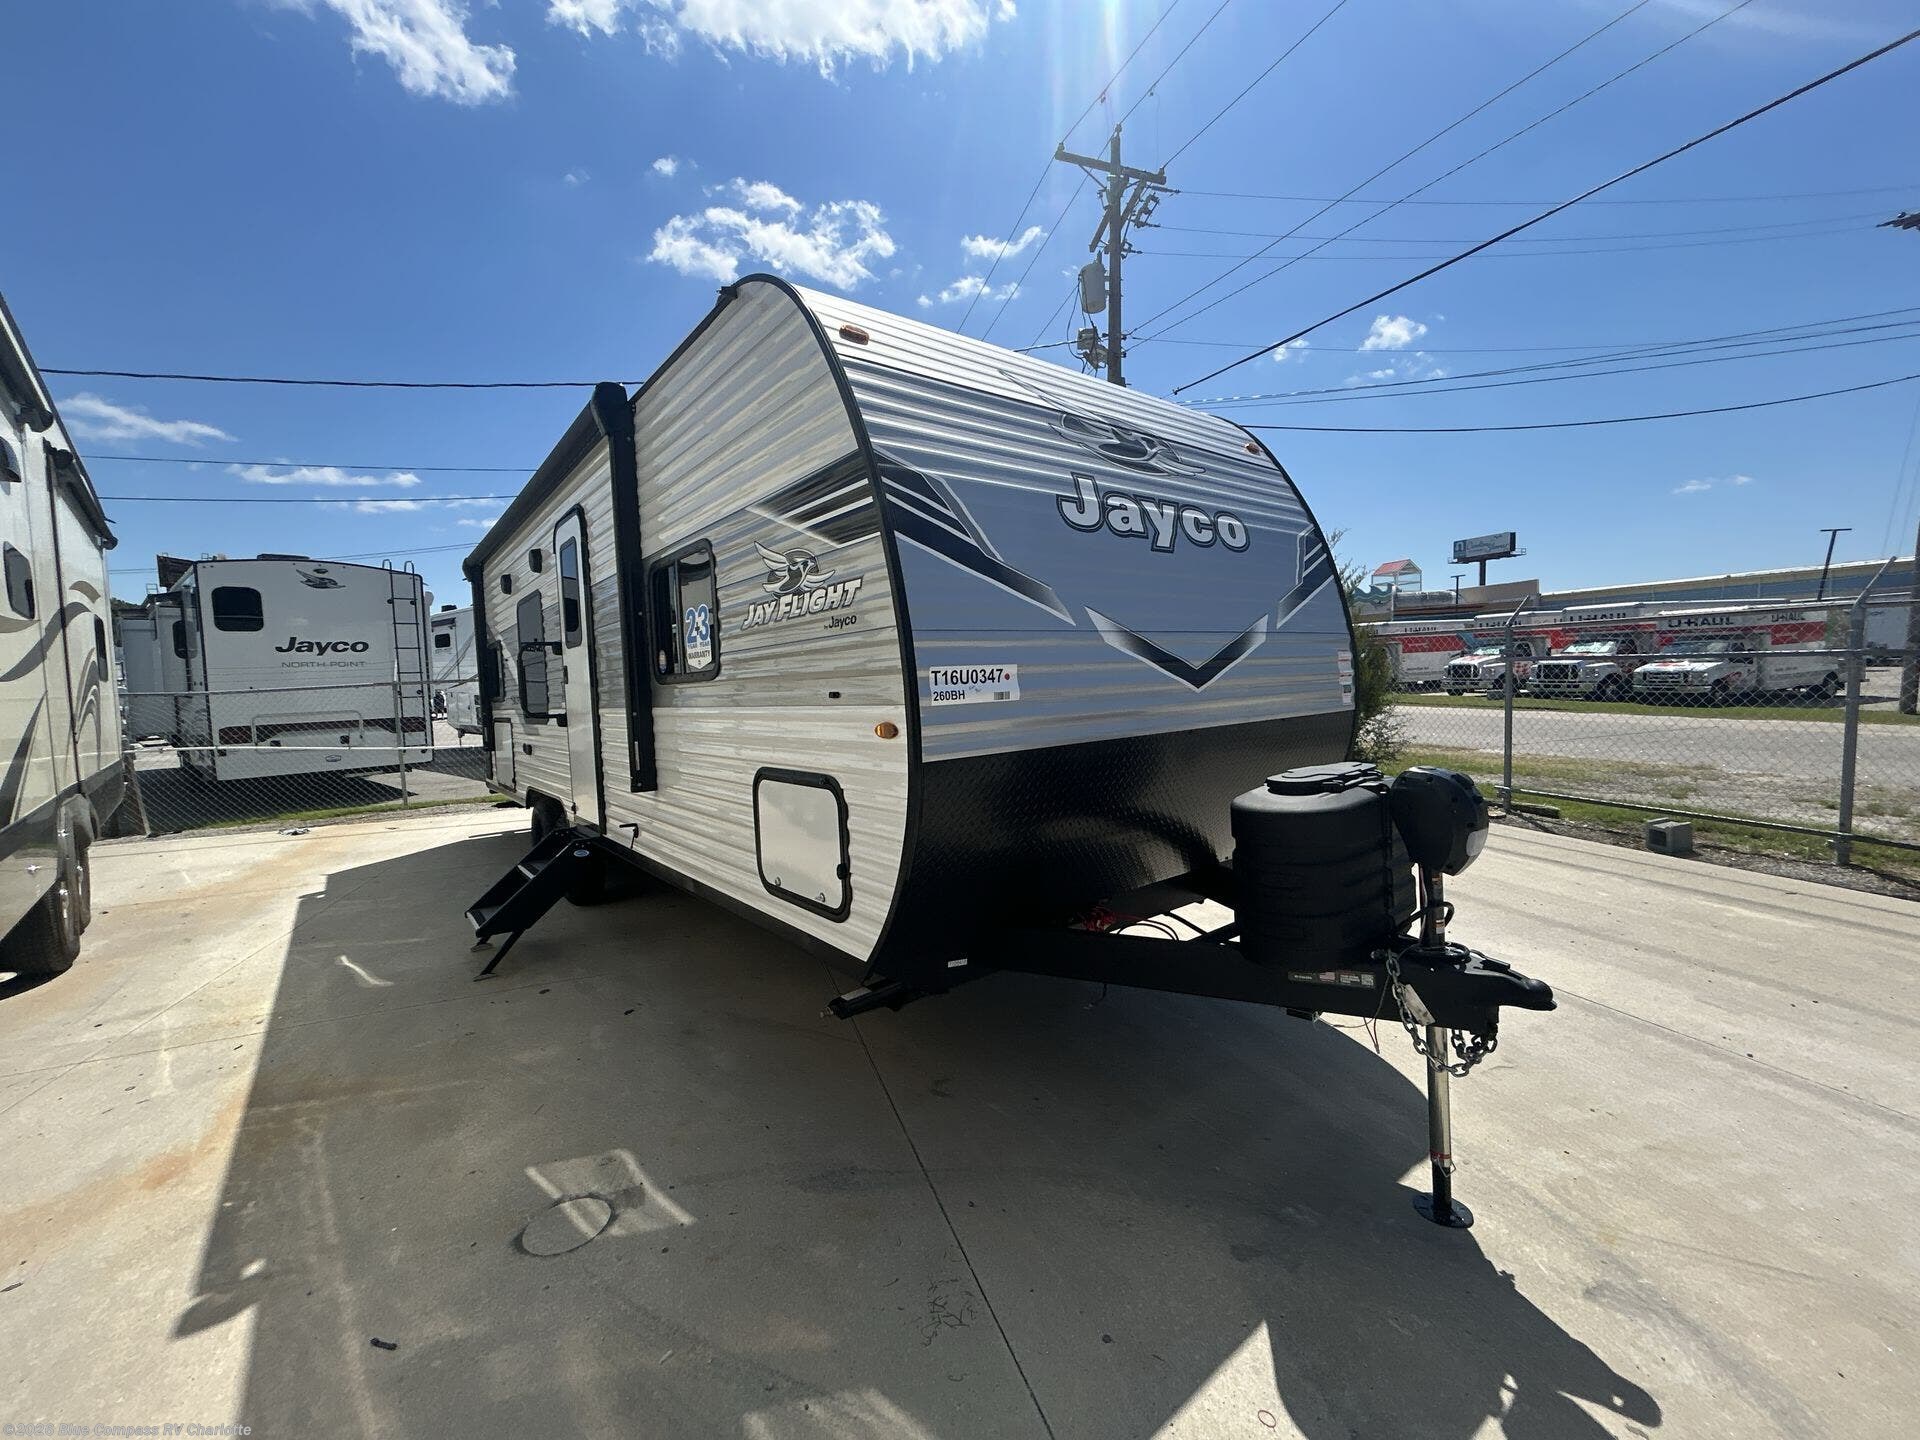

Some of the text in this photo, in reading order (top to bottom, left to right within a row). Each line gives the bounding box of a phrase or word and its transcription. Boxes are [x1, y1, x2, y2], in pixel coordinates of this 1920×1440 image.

[1056, 472, 1250, 553] Jayco
[741, 575, 863, 630] JAY FLIGHT
[828, 614, 857, 630] Jayco
[1668, 616, 1735, 628] U-HAUL
[275, 636, 369, 656] Jayco
[688, 650, 710, 660] WARRANTY
[931, 668, 1004, 686] T16U0347
[933, 690, 966, 702] 260BH
